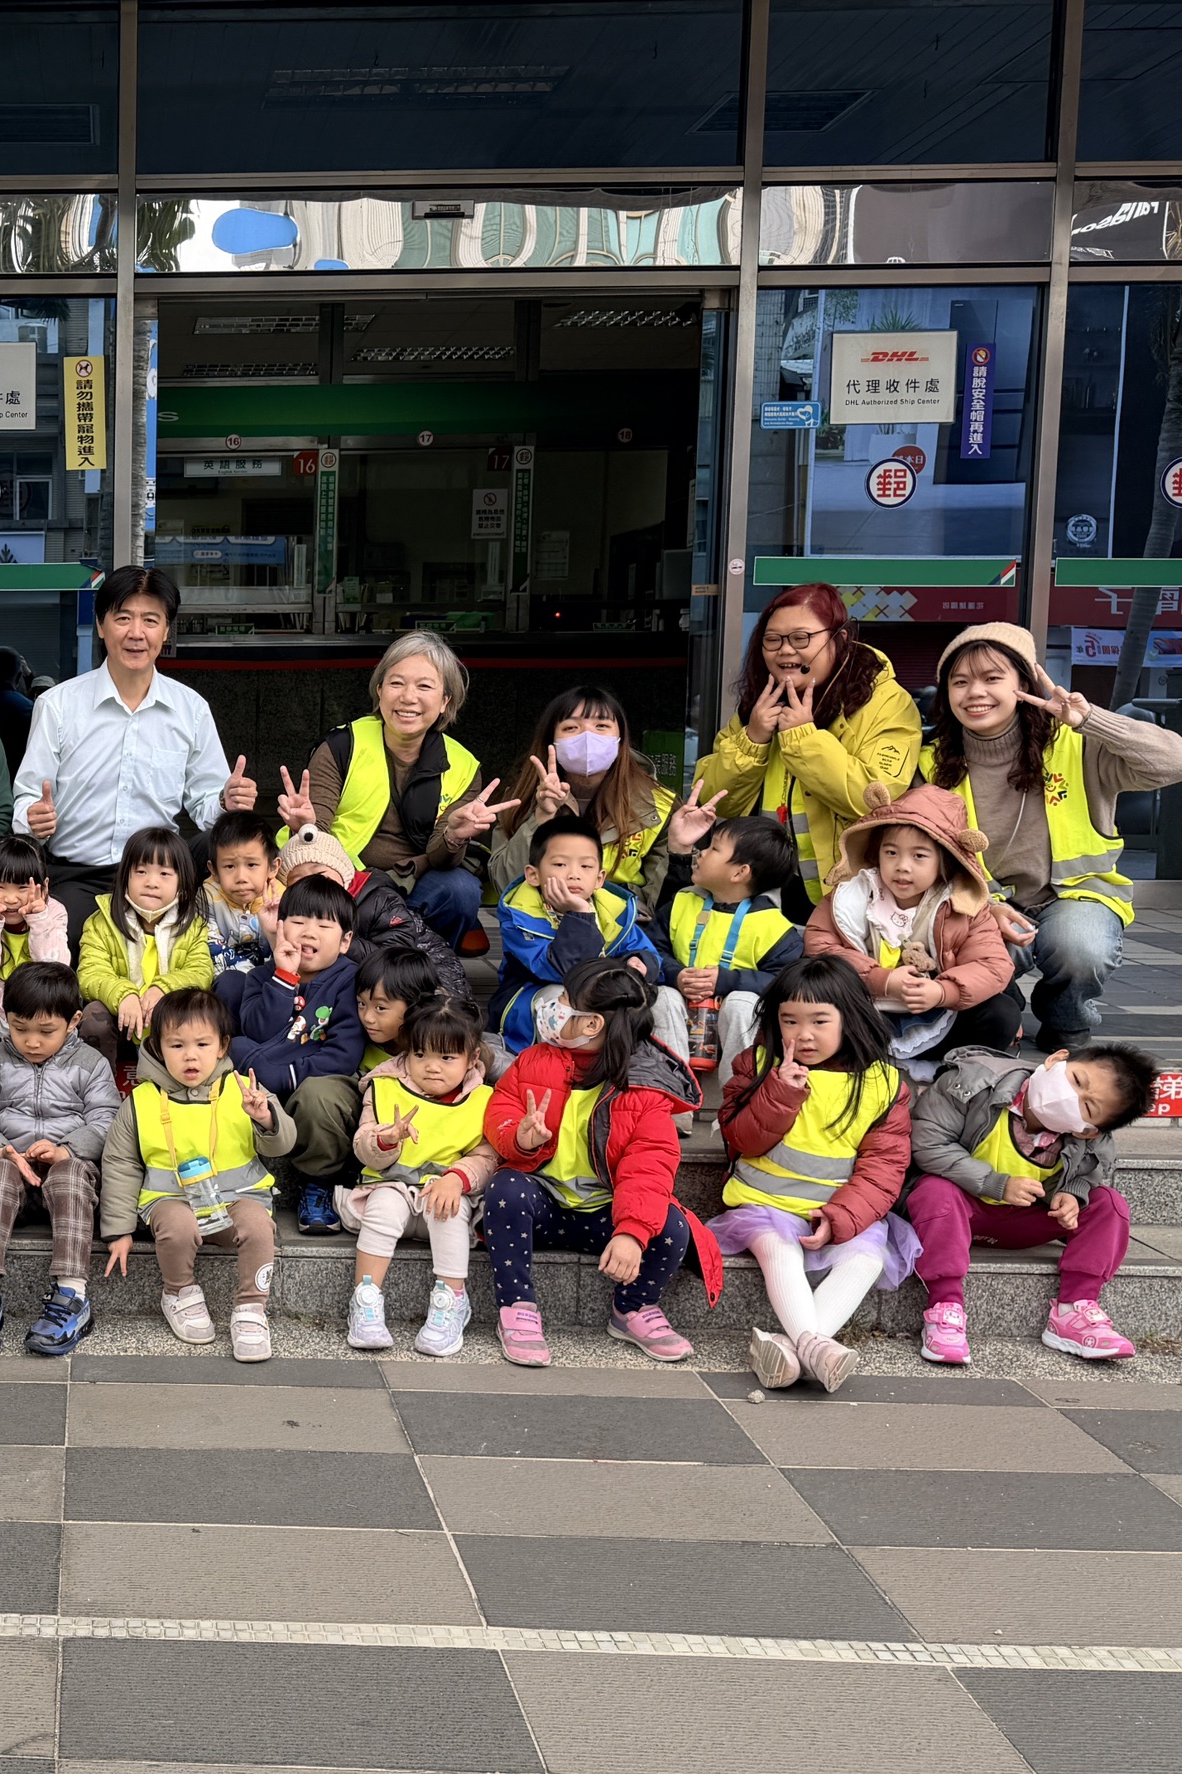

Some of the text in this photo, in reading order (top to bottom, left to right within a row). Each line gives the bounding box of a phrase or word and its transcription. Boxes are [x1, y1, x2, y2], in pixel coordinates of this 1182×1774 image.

[870, 350, 920, 363] DHL
[845, 378, 940, 395] 代理收件處
[968, 366, 988, 455] 請脫安全帽再進入
[76, 379, 95, 467] 請勿攜帶寵物進入
[227, 437, 240, 446] 16
[419, 433, 433, 443] 17
[619, 430, 631, 440] 18
[203, 459, 263, 470] 英語服務
[298, 458, 316, 474] 16
[493, 454, 510, 470] 17
[876, 468, 908, 498] 郵
